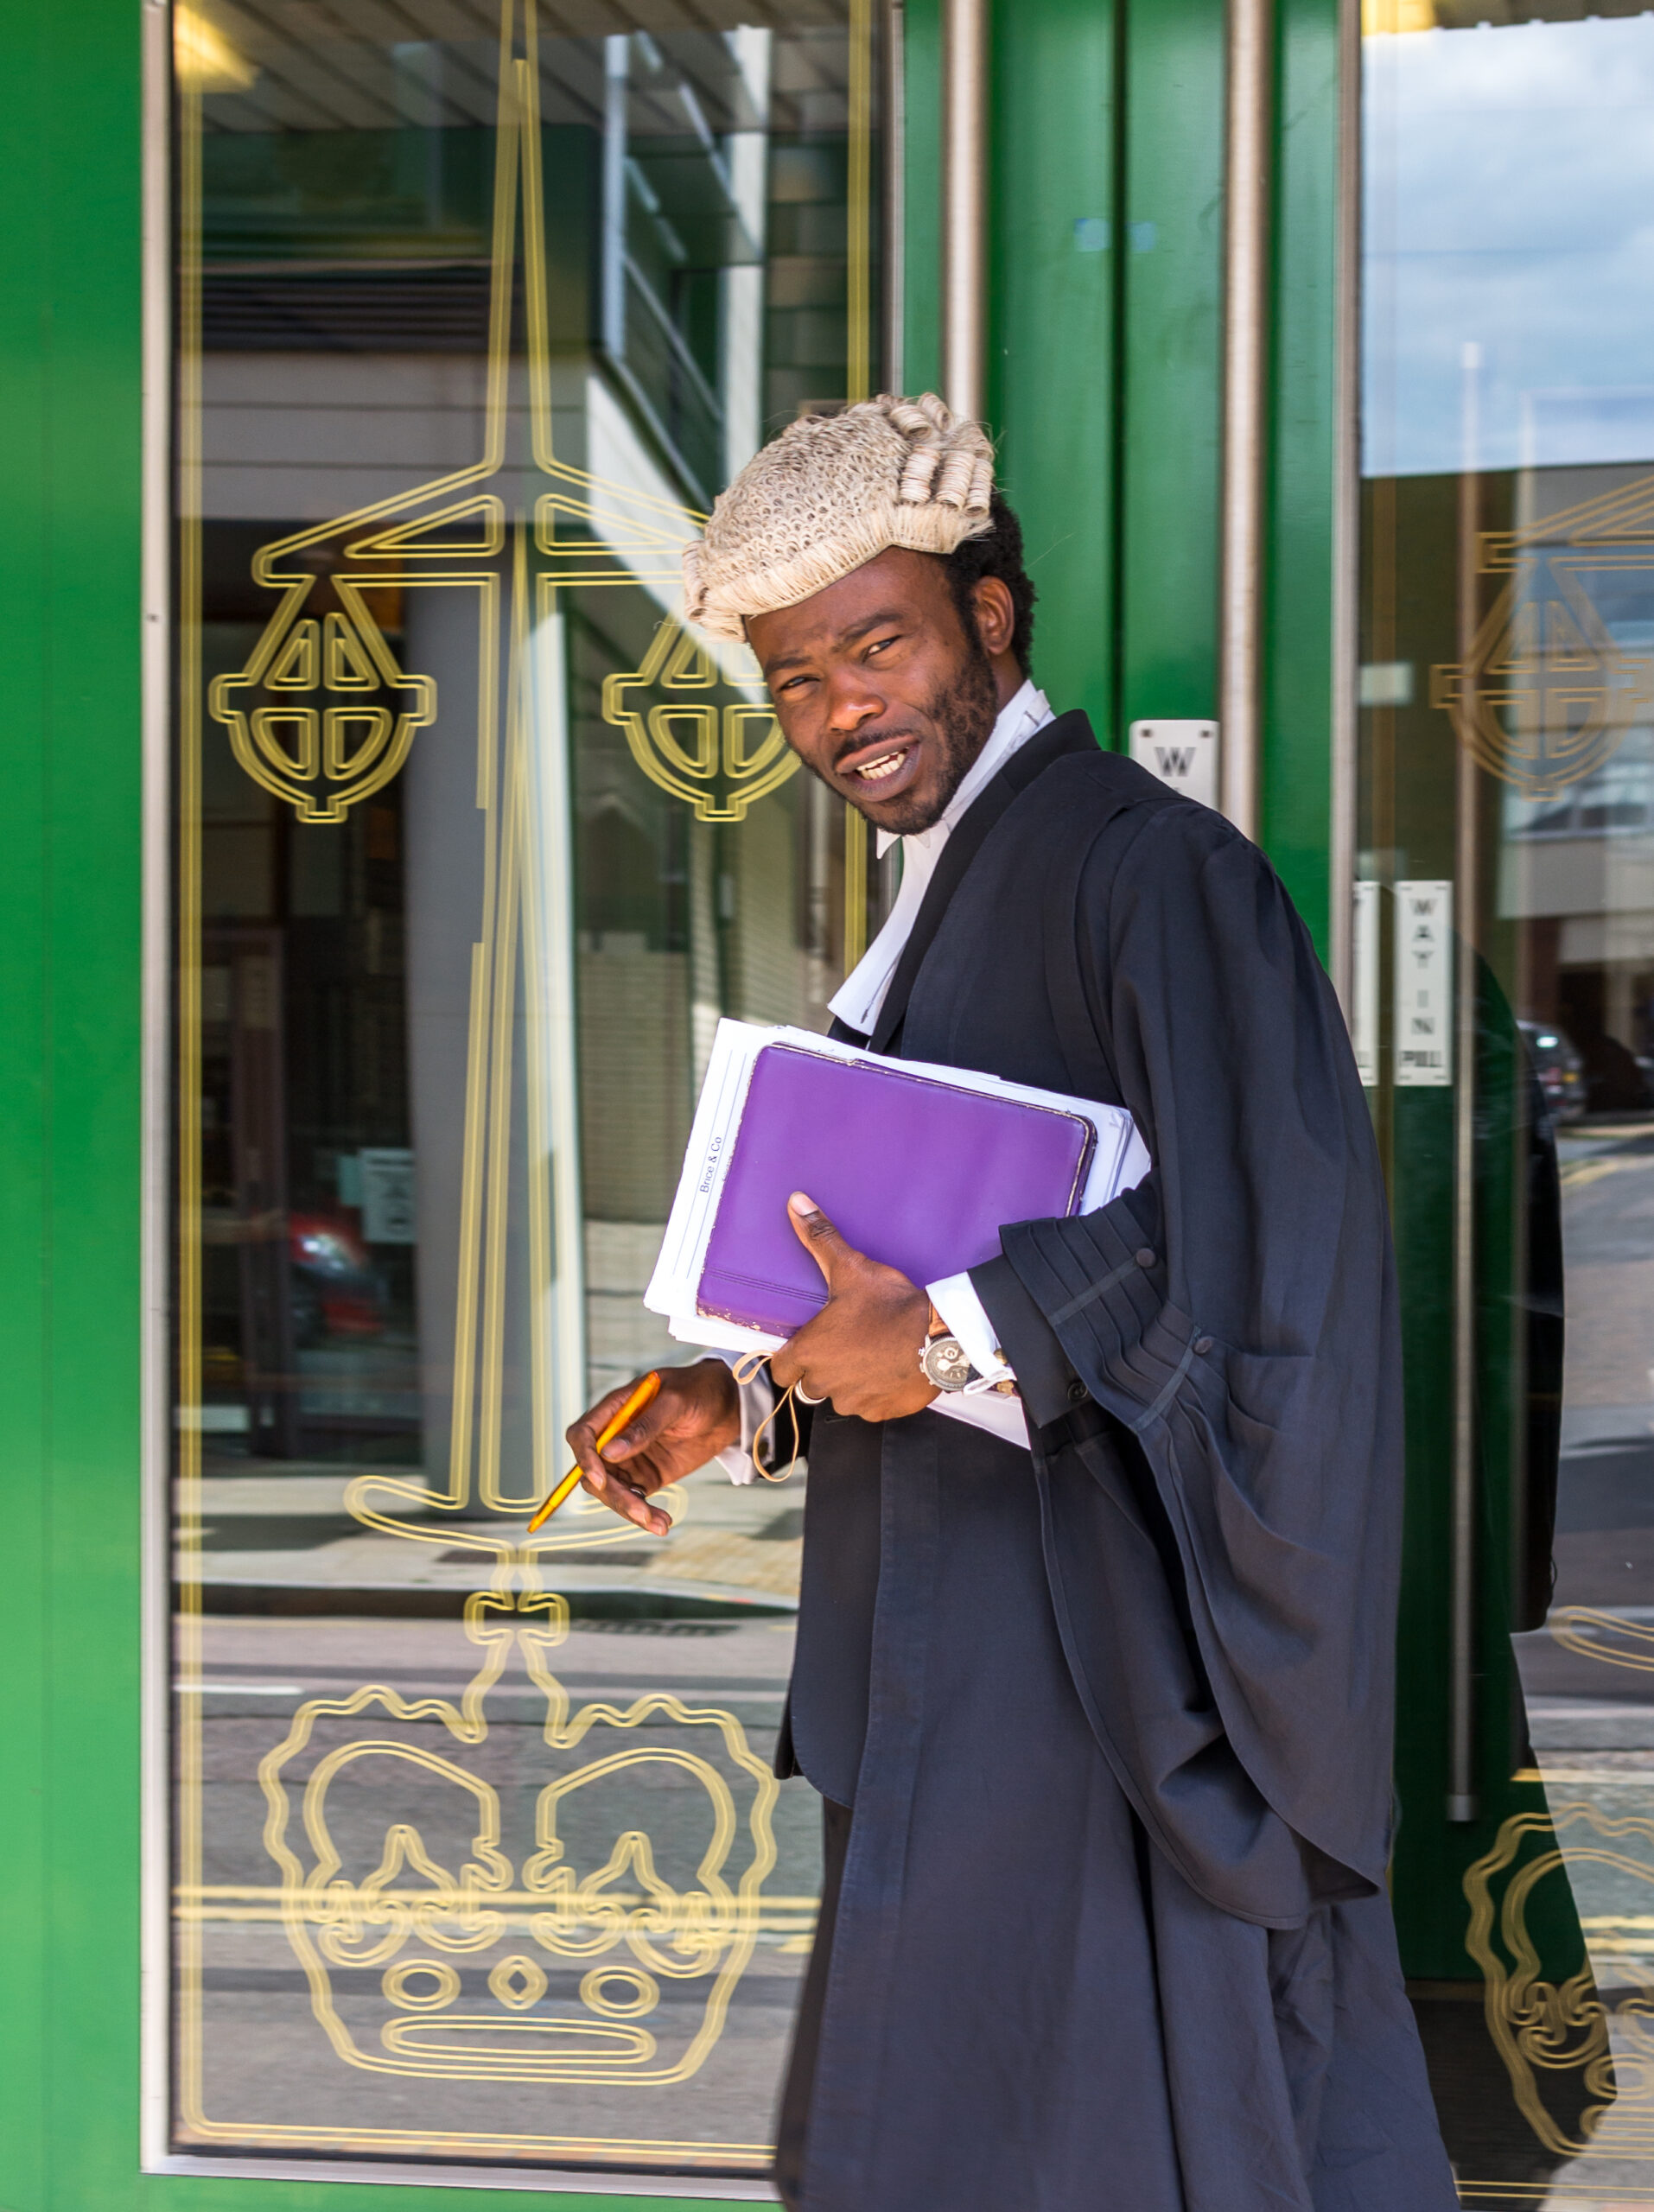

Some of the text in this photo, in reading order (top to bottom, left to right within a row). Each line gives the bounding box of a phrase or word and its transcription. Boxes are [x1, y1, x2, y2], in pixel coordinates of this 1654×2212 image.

[1409, 899, 1438, 1035] WAY IN
[699, 1166, 715, 1193] Brice
[710, 1136, 722, 1152] Co
